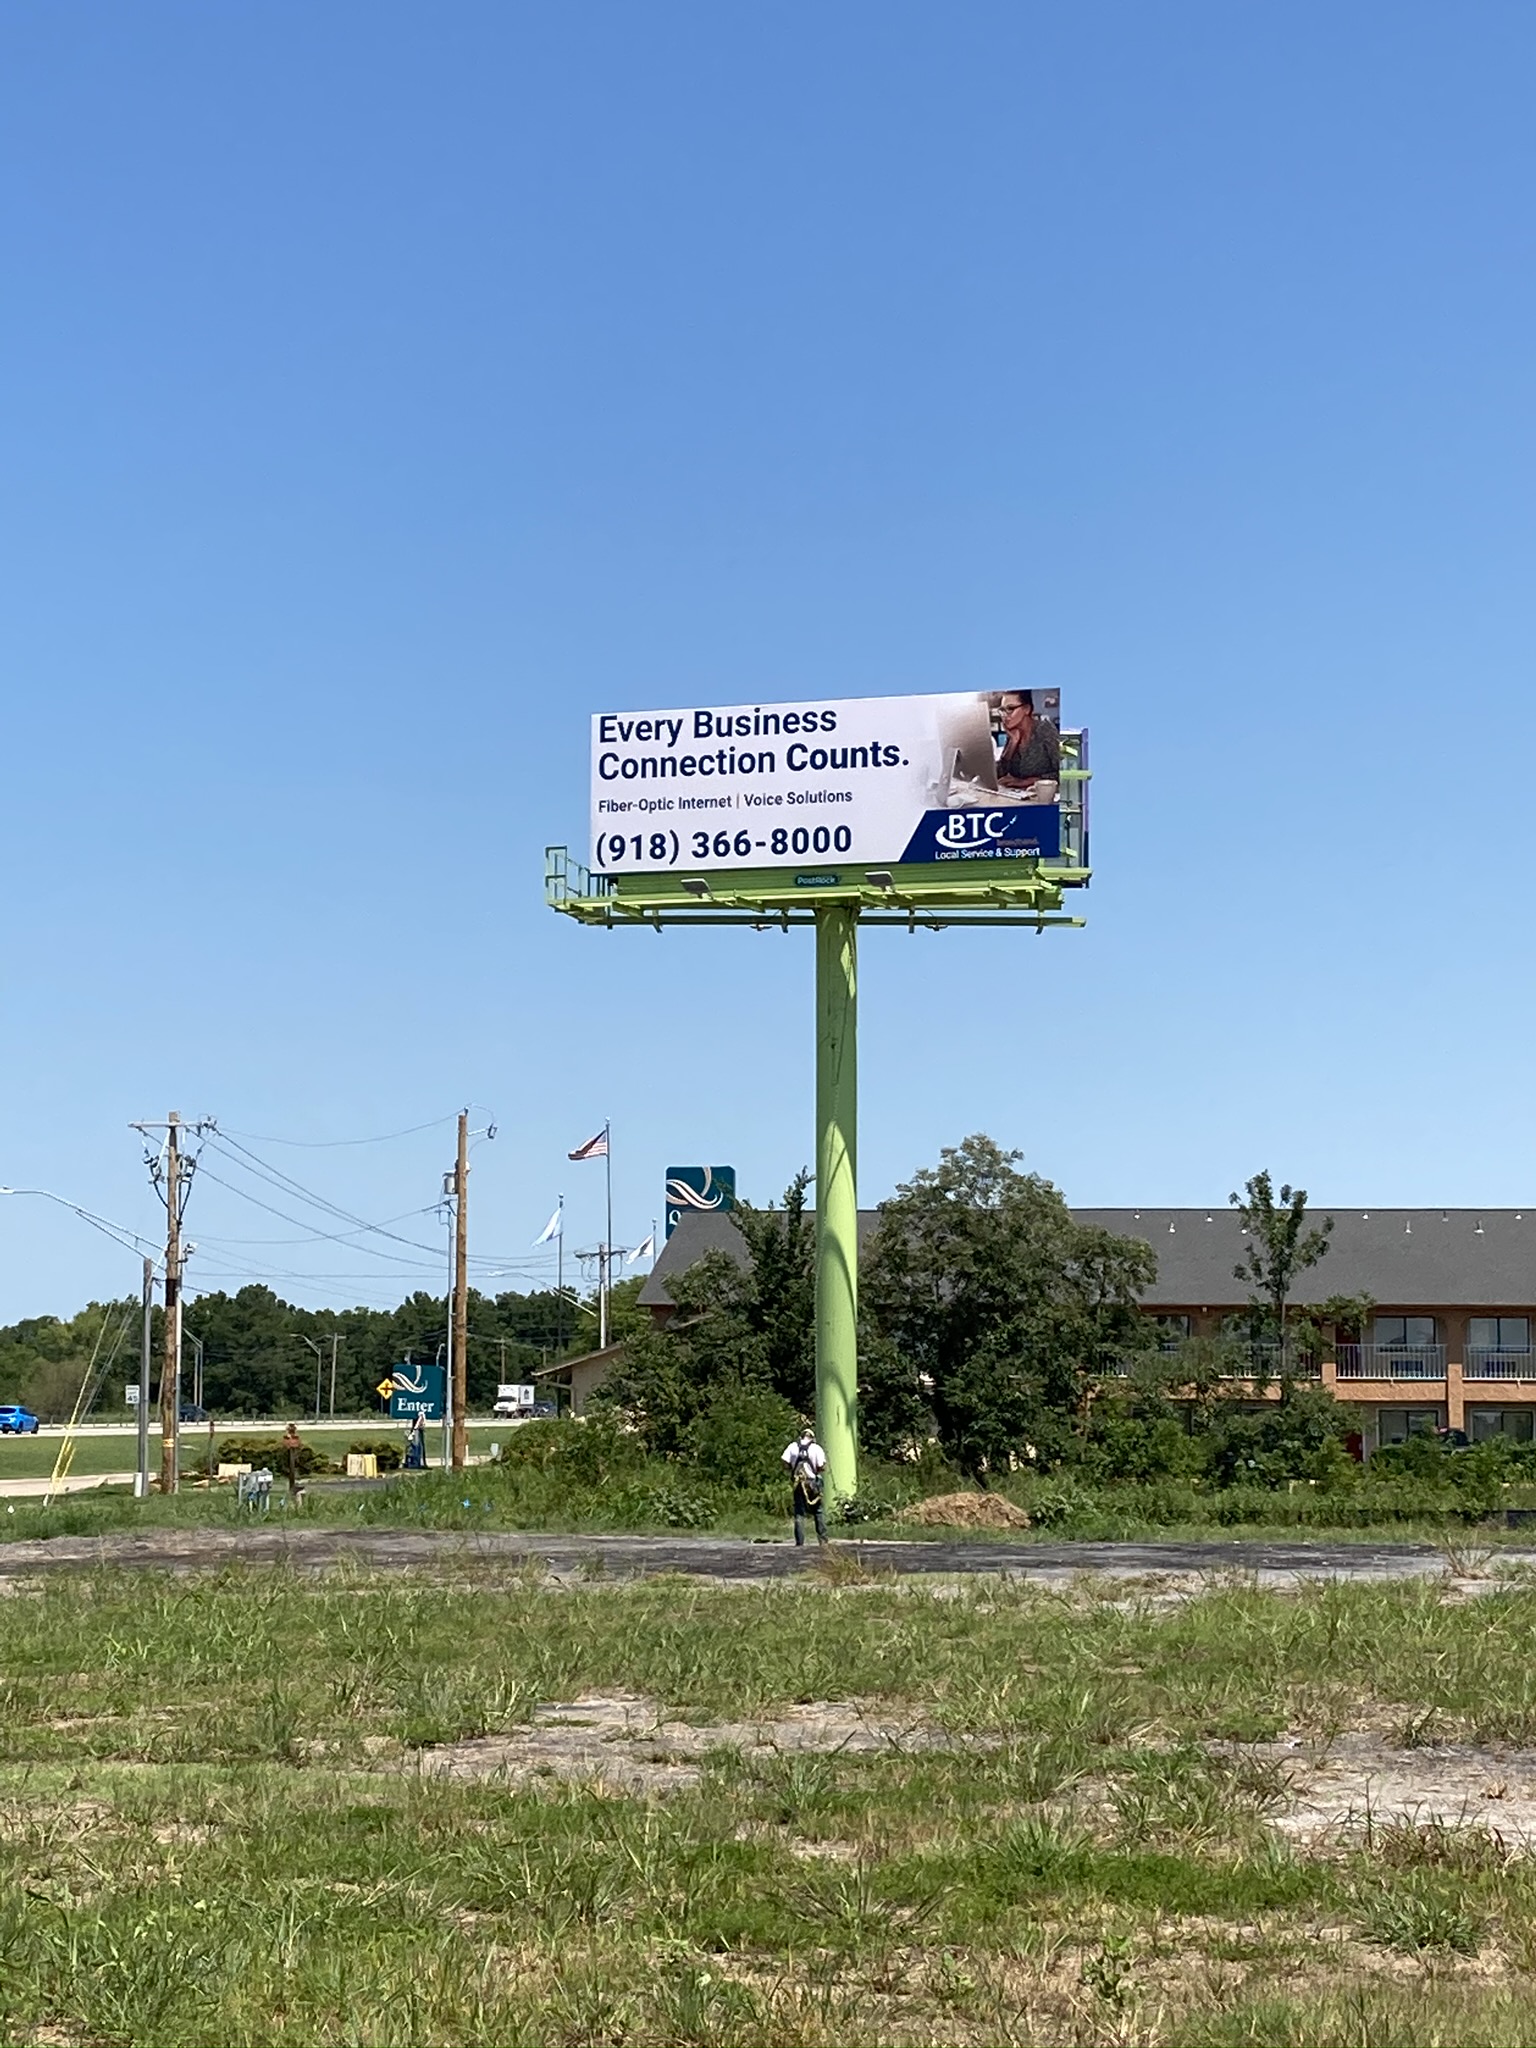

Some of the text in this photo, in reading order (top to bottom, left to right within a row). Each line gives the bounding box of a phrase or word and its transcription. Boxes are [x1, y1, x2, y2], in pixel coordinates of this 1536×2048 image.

[599, 707, 837, 748] Every Business
[599, 741, 910, 781] Connection Counts.
[598, 798, 675, 814] Fiber-Optic
[678, 795, 732, 810] Internet
[743, 793, 783, 807] Voice
[786, 789, 853, 805] Solutions
[948, 812, 1004, 839] BTC
[596, 825, 852, 868] (918) 366-8000
[935, 847, 1040, 860] Local Service & Support
[397, 1397, 435, 1413] Enter
